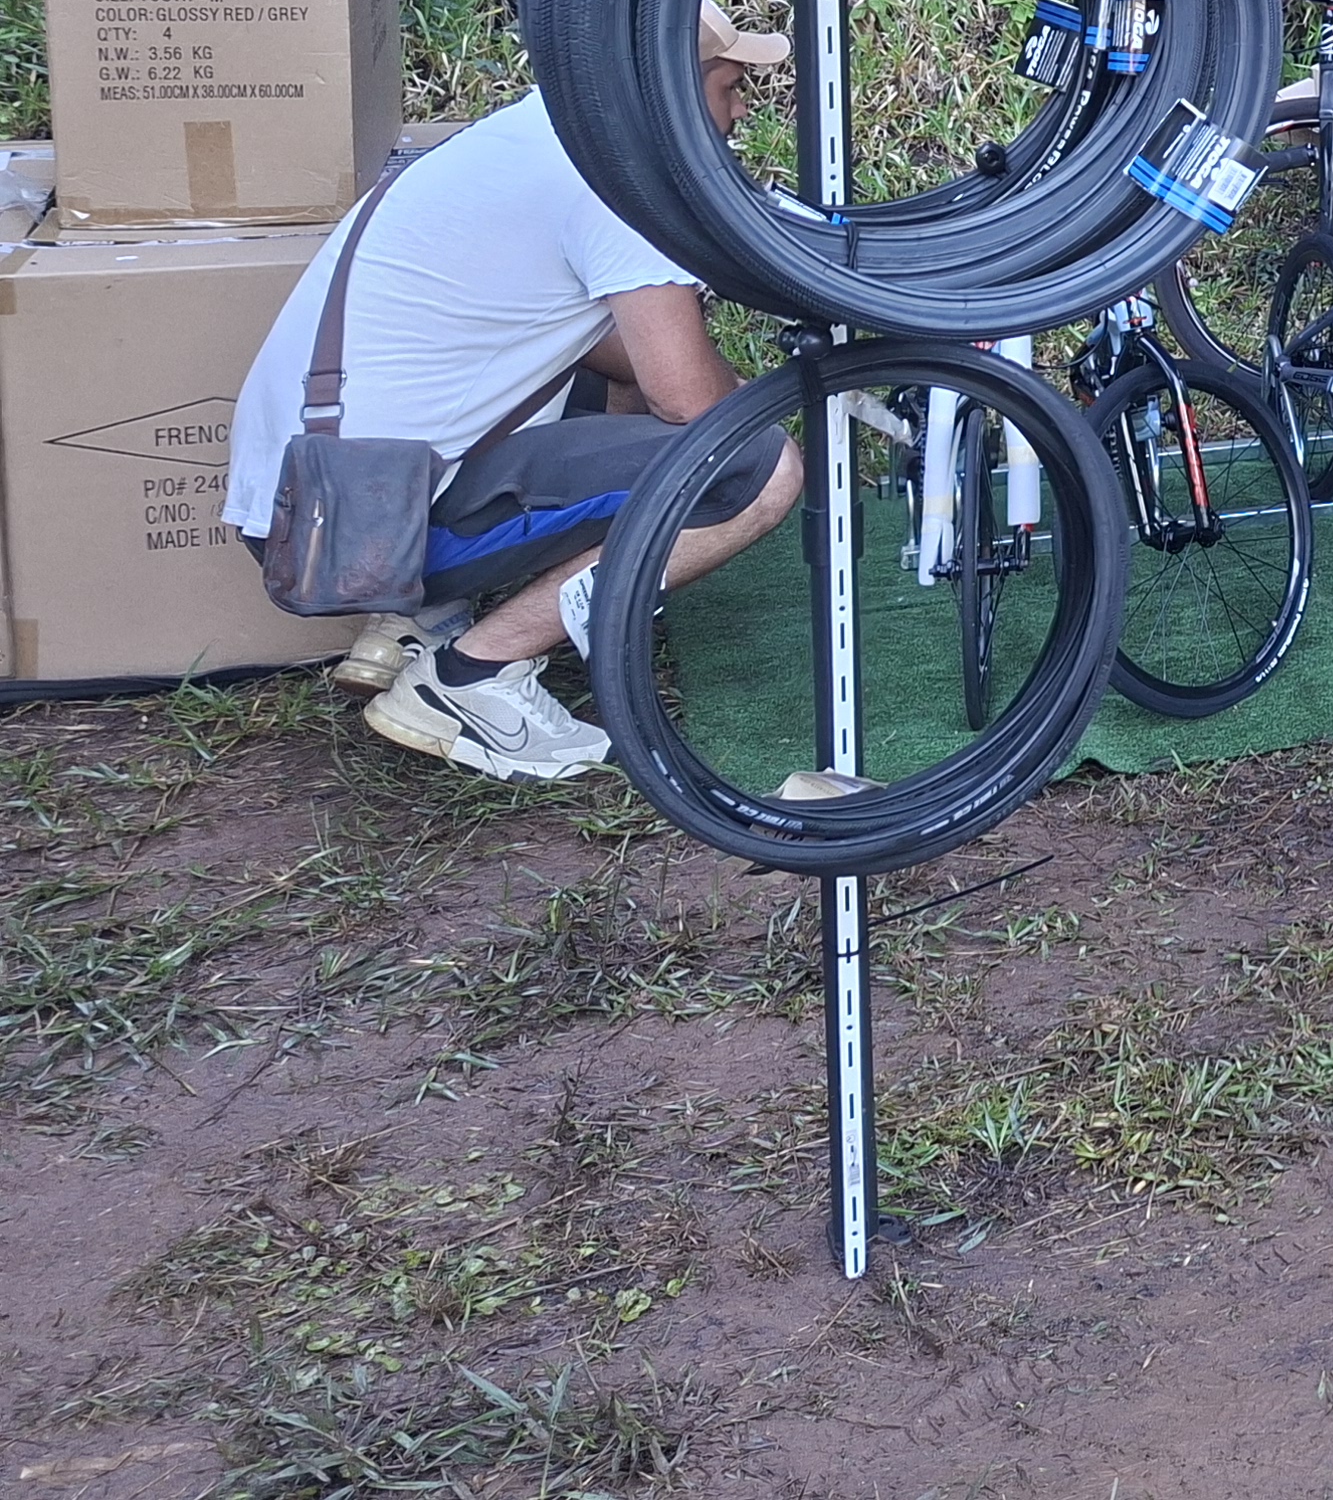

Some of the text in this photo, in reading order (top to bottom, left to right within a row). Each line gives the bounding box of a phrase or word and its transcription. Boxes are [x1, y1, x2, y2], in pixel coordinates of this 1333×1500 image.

[95, 7, 309, 22] COLOR: GLOSSY RED / GREY
[163, 26, 172, 40] 4
[148, 46, 182, 60] 3.56
[192, 46, 213, 60] KG
[148, 66, 182, 80] 6.22
[193, 65, 214, 79] KG
[100, 83, 304, 100] MEAS: 51.00CM X 38.00CM X 60.00CM
[143, 477, 187, 499] P/O#
[145, 502, 196, 525] C/NO:
[146, 528, 201, 551] MADE
[208, 525, 227, 546] IN
